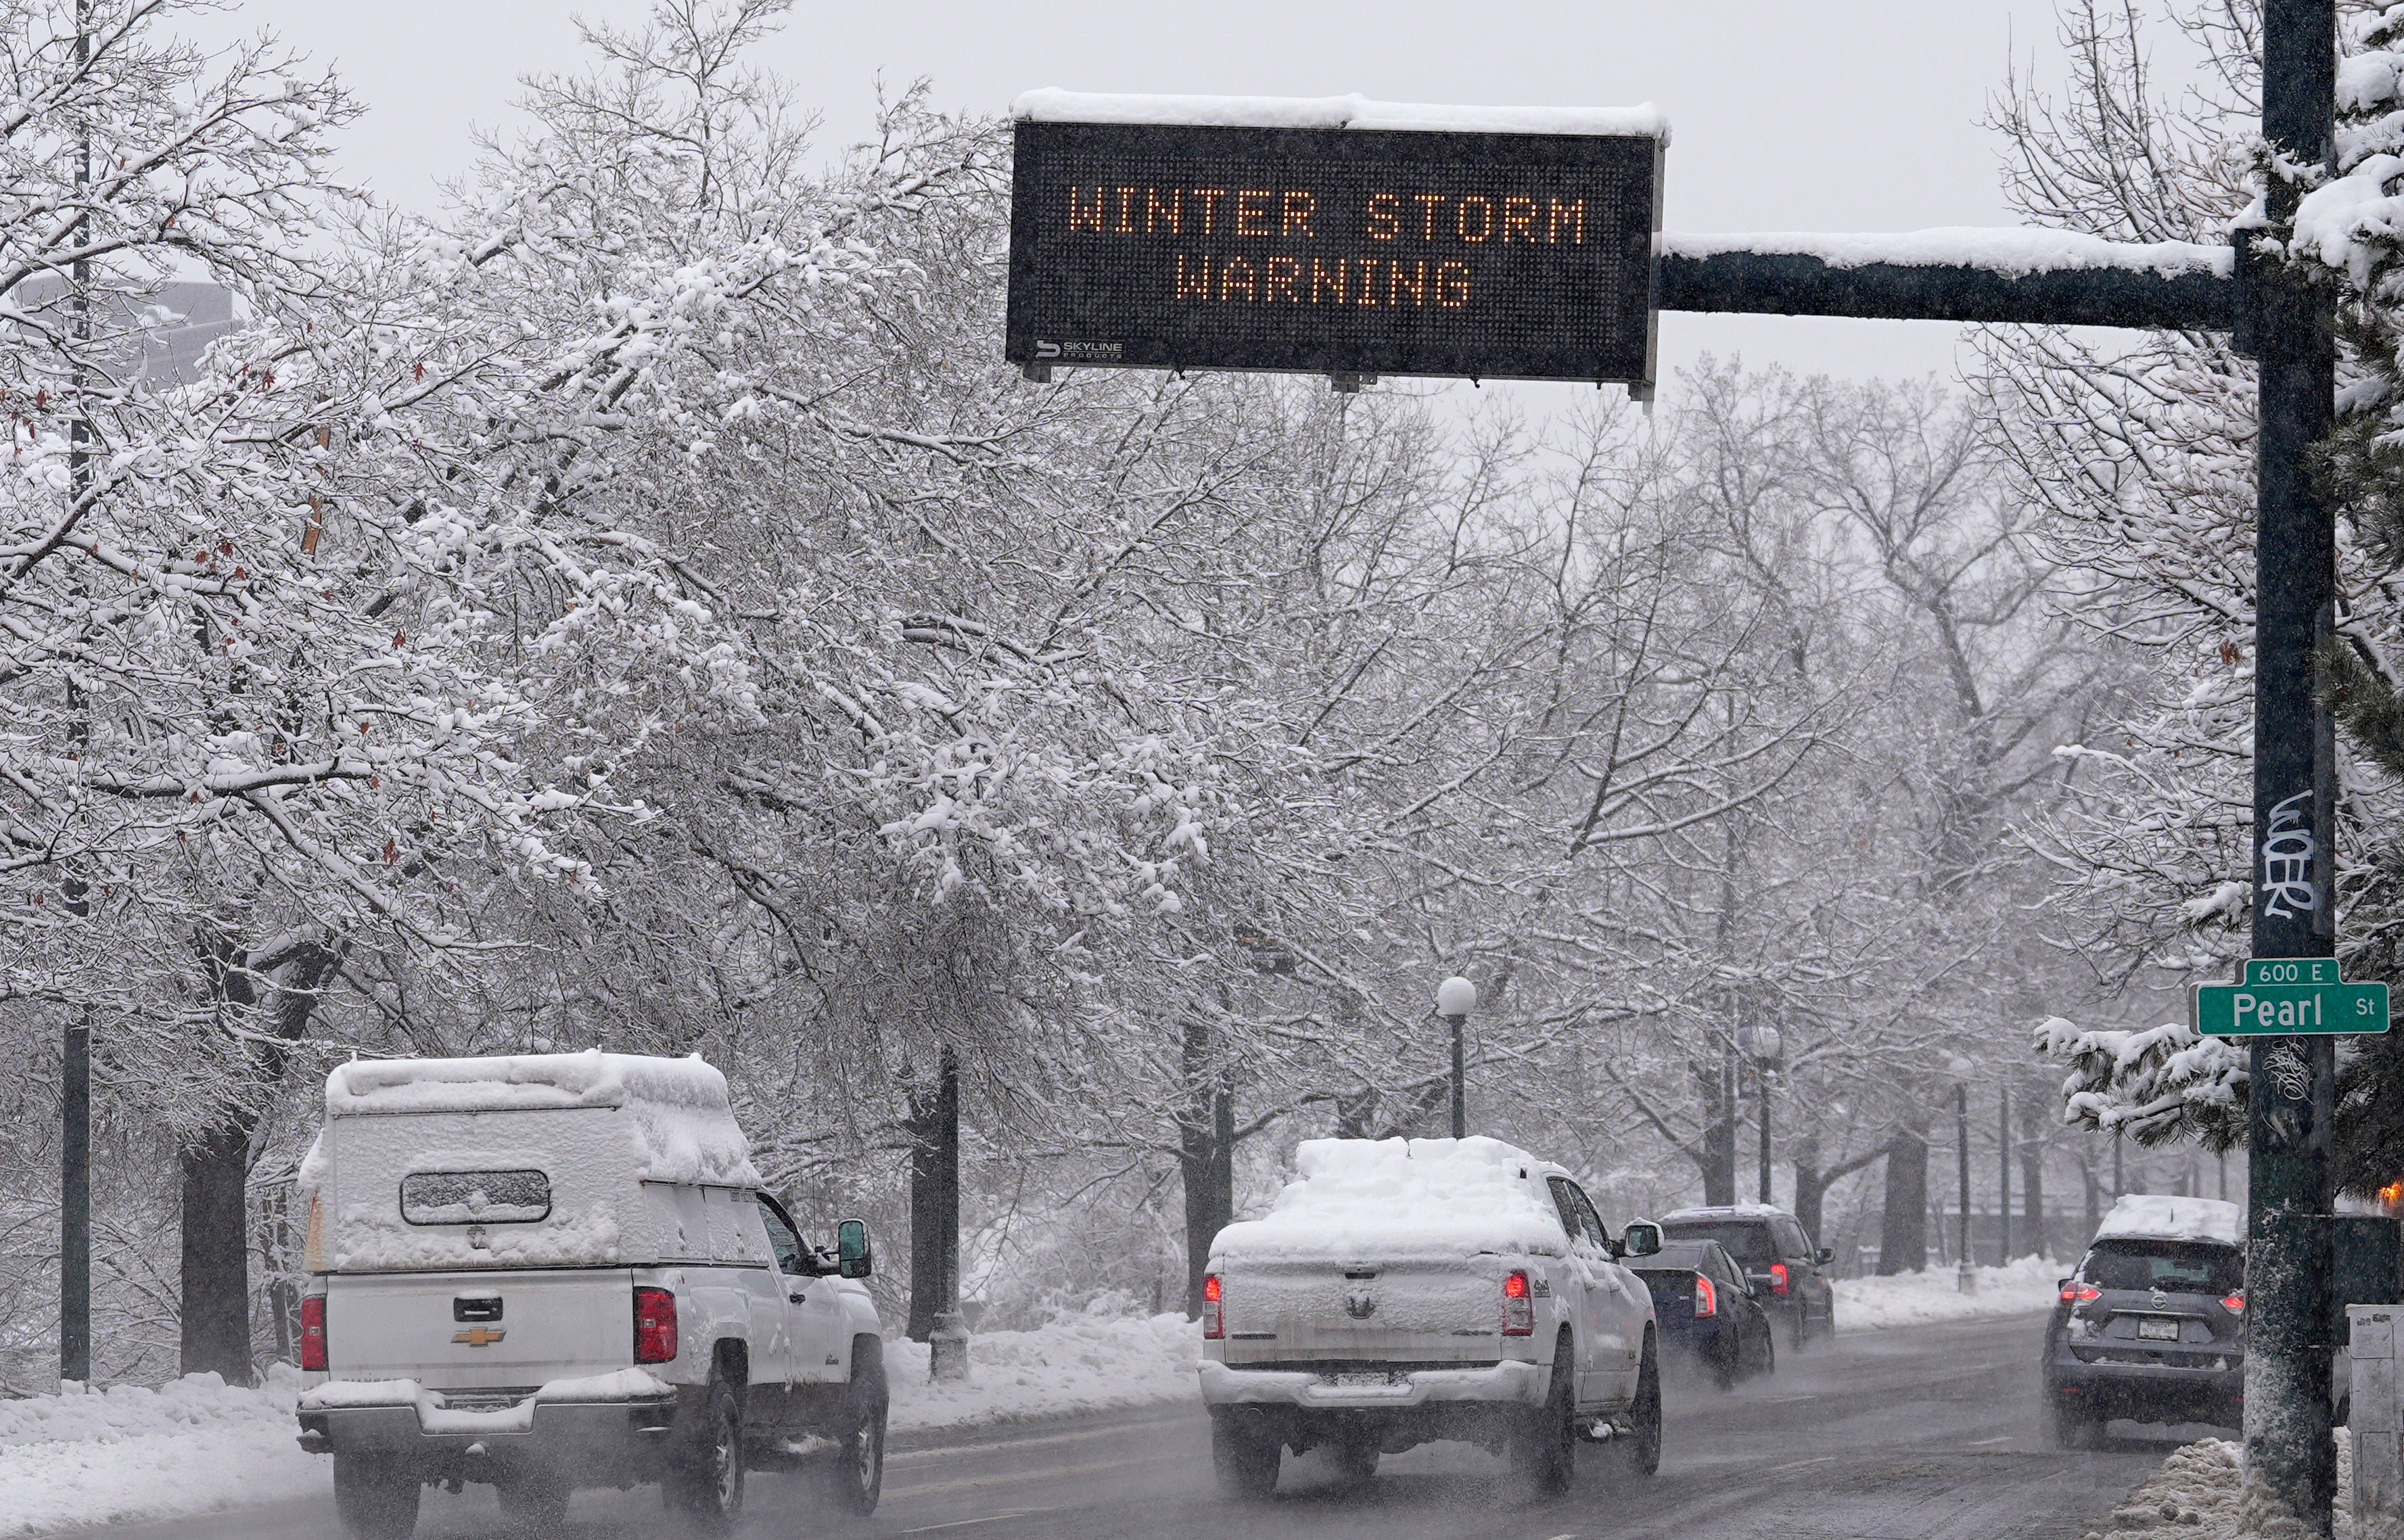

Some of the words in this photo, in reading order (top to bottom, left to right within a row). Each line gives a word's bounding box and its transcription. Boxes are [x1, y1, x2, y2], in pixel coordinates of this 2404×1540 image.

[1069, 185, 1318, 237] WINTER
[1366, 192, 1585, 245] STORM
[1176, 253, 1471, 308] WARNING
[1063, 342, 1123, 352] SKYLINE
[2259, 964, 2298, 982] 600
[2311, 964, 2323, 981] E
[2234, 993, 2321, 1027] Pearl
[2355, 998, 2375, 1016] St
